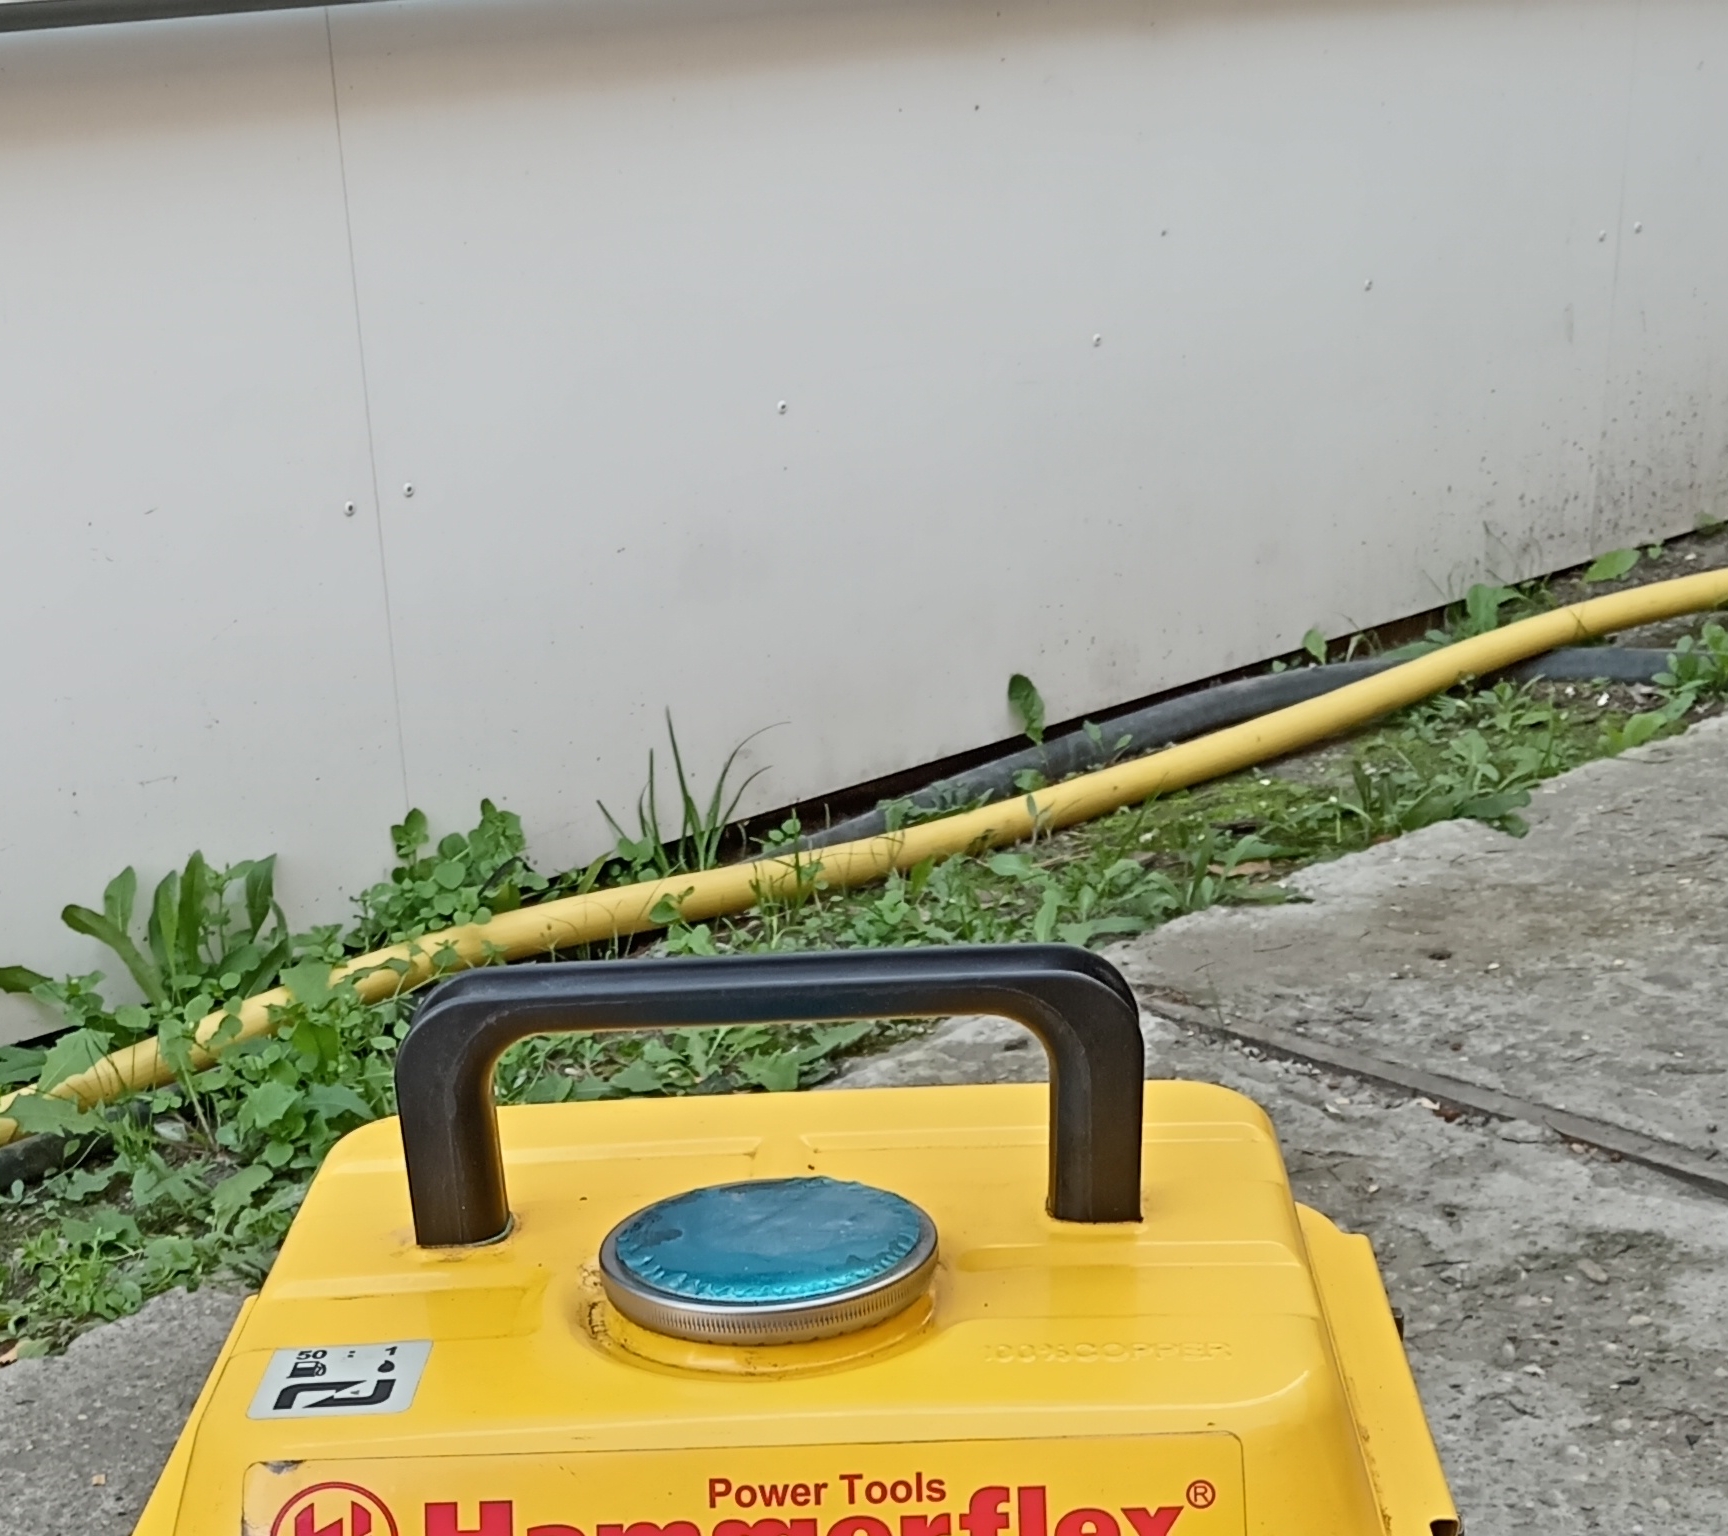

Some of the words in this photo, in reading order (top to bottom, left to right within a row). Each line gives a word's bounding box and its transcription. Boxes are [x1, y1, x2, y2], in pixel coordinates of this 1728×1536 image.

[296, 1350, 327, 1360] 50
[385, 1346, 398, 1356] 1
[708, 1477, 829, 1509] Power
[838, 1472, 947, 1505] Tools
